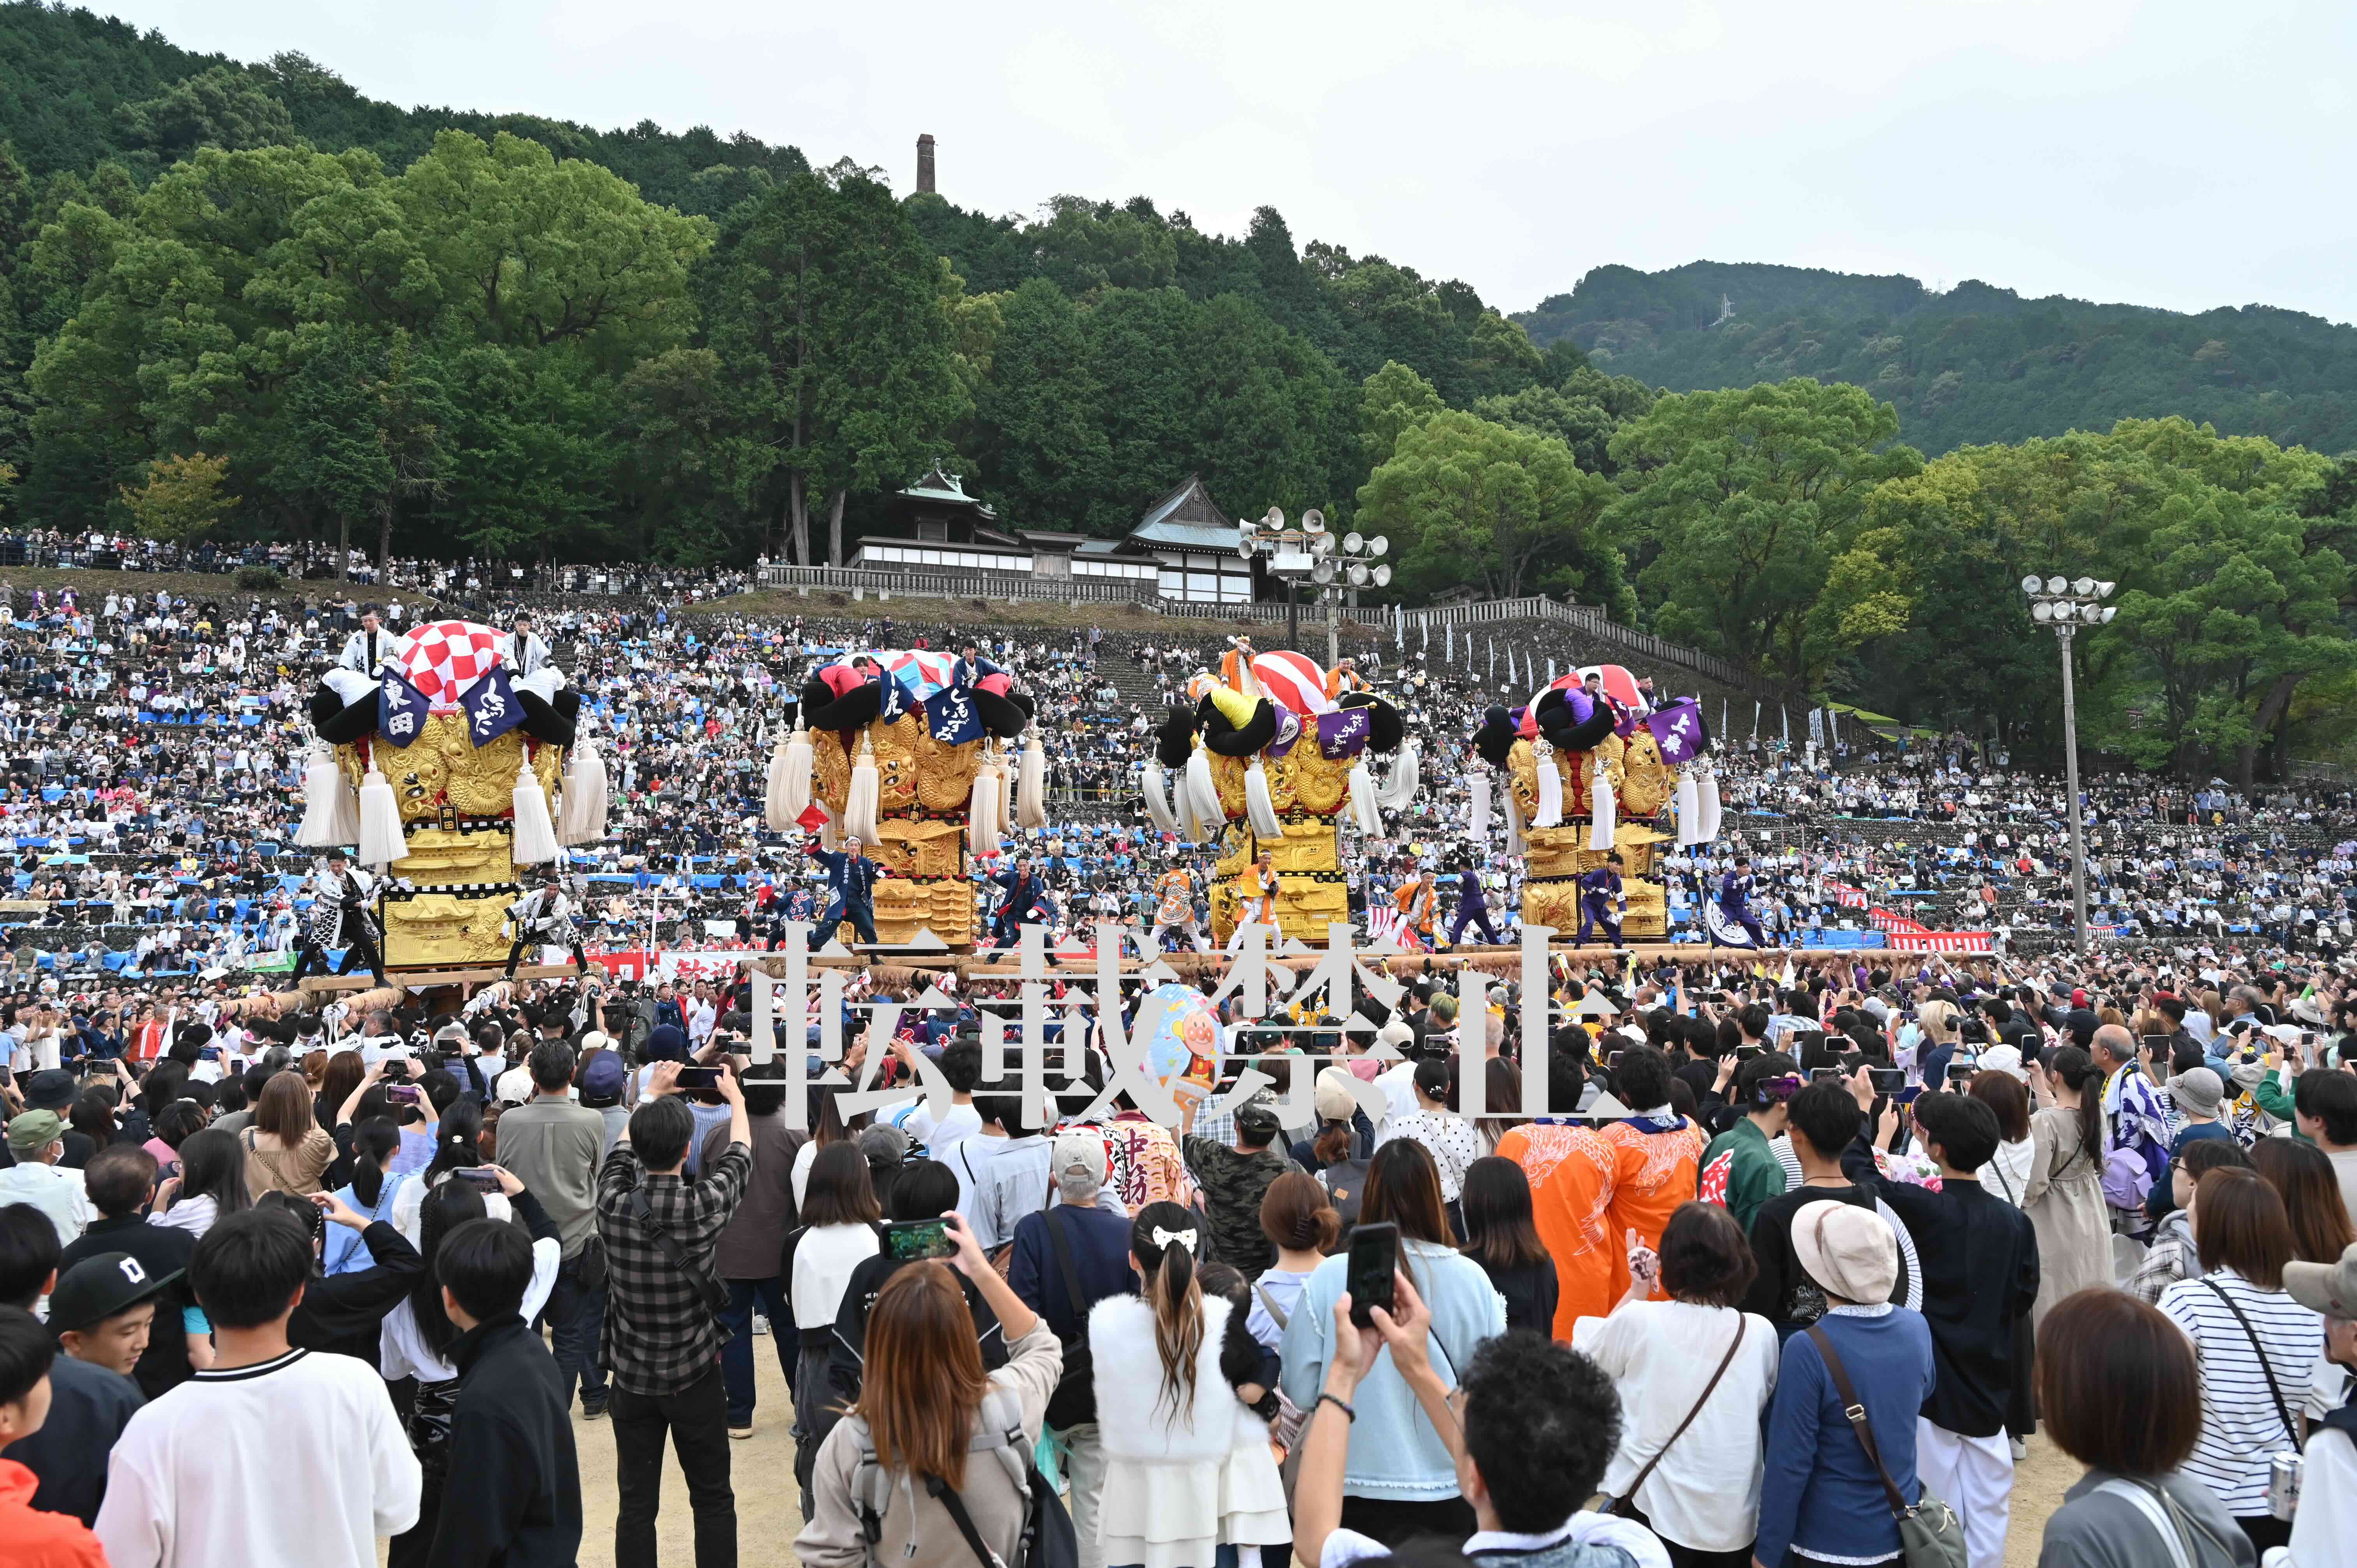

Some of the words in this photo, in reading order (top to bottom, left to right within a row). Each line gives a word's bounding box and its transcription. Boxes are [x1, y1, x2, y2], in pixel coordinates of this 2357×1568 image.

[384, 678, 412, 735] 東田
[475, 677, 505, 735] とうだ
[936, 688, 970, 740] しもいずみ
[1326, 714, 1364, 755] 松木坂井
[442, 808, 454, 829] 東田
[1120, 1128, 1148, 1205] 中筋
